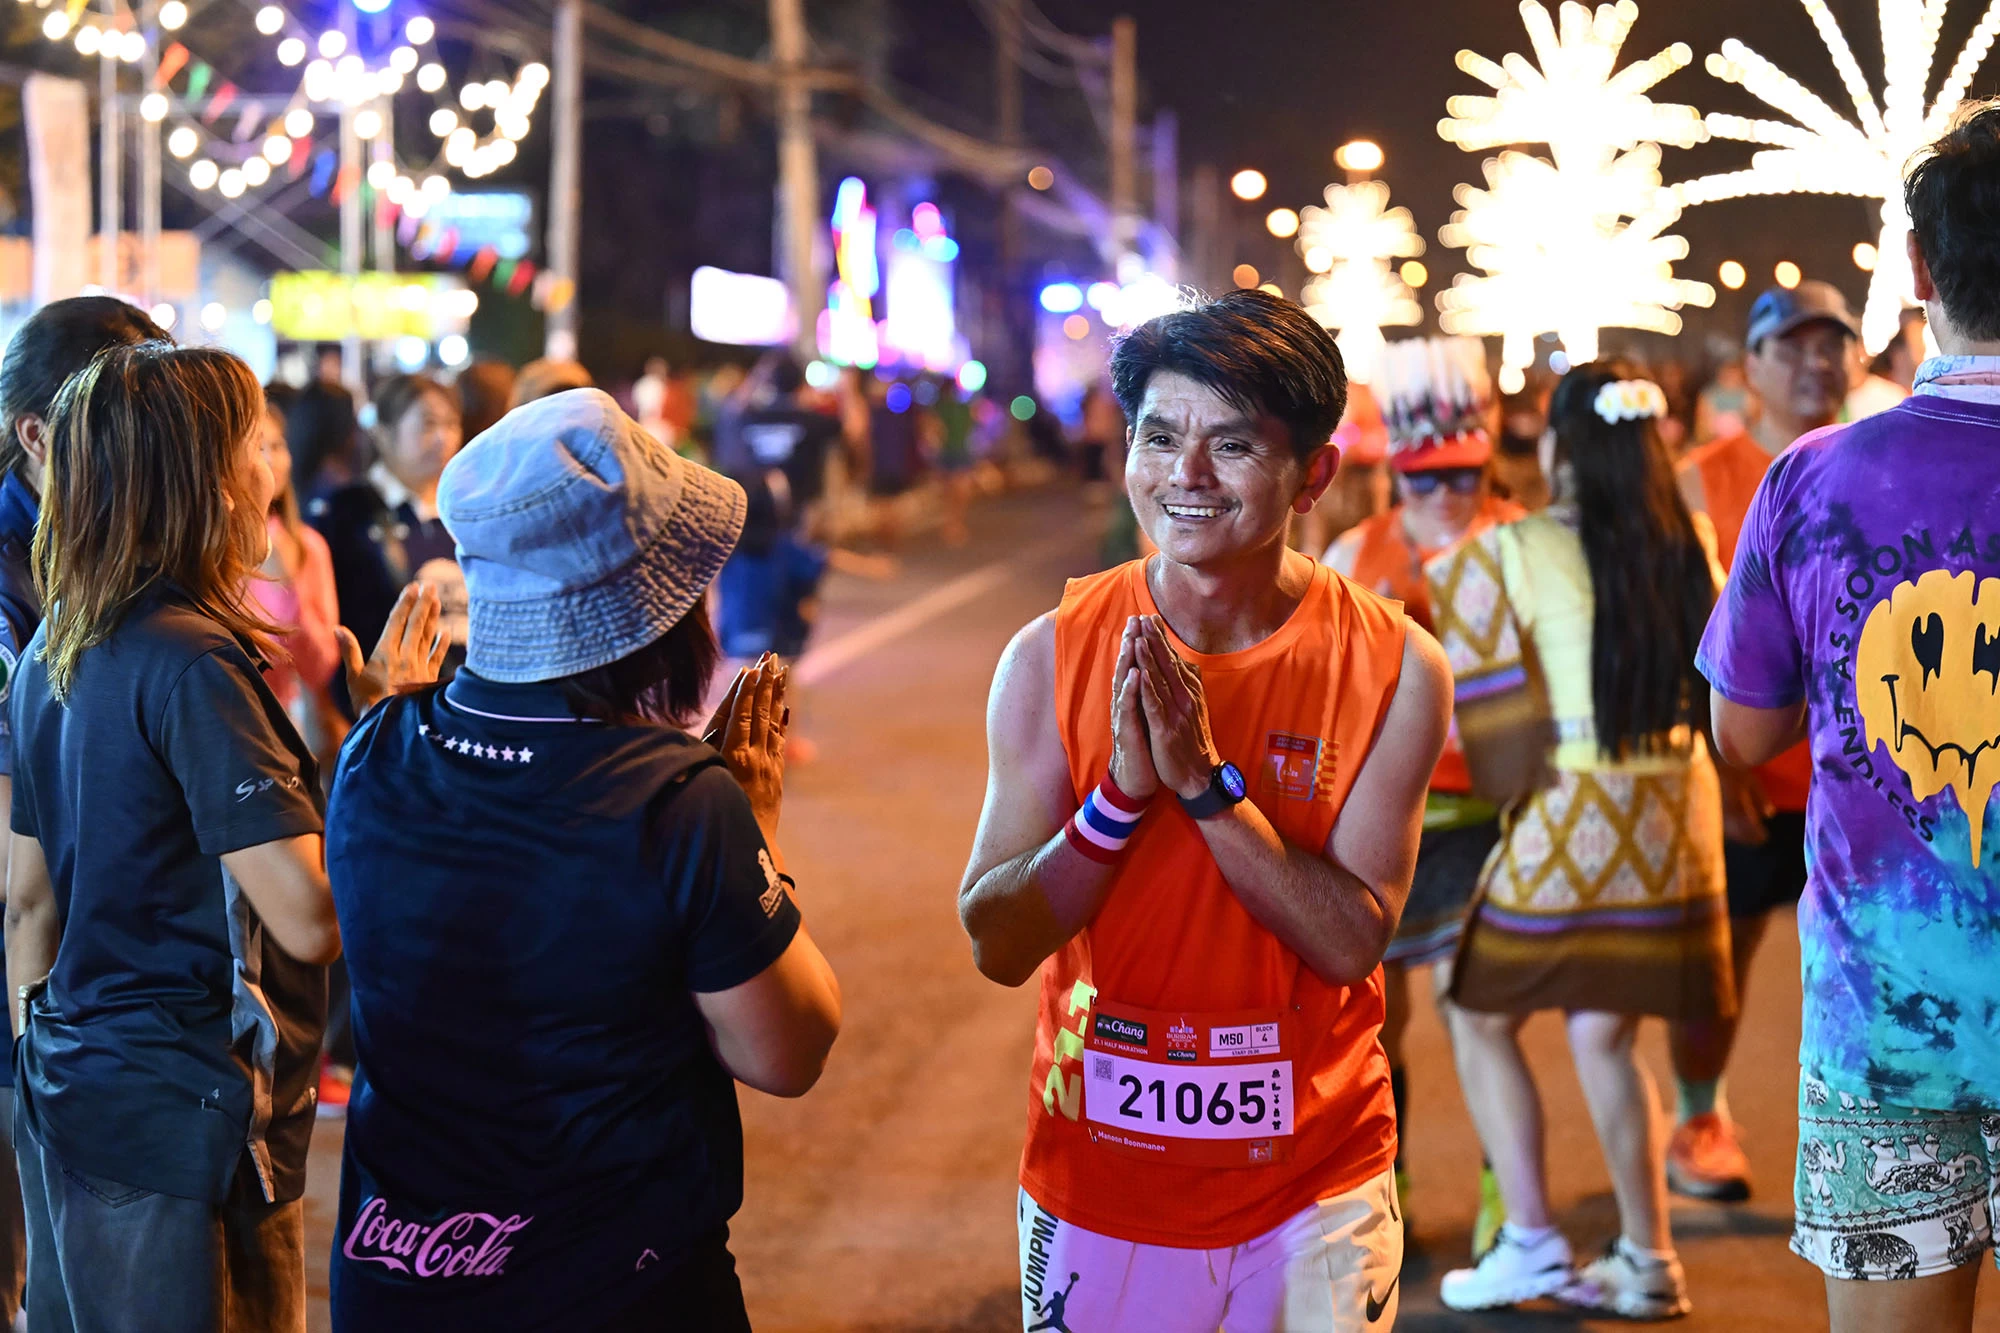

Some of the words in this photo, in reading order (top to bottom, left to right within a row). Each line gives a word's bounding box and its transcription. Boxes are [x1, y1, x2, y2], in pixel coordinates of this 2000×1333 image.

[1835, 528, 1936, 622] SOON
[1830, 631, 1852, 681] AS
[1111, 1020, 1144, 1040] Chang
[1219, 1032, 1243, 1046] M50
[1261, 1033, 1268, 1043] 4
[1104, 1040, 1118, 1050] HALF
[1118, 1043, 1149, 1055] MARATHON
[1176, 1050, 1196, 1059] Chang
[1118, 1074, 1266, 1126] 21065
[1097, 1130, 1123, 1145] Manoon
[1123, 1136, 1166, 1152] Boonmanee
[343, 1197, 535, 1278] Coca-Cola
